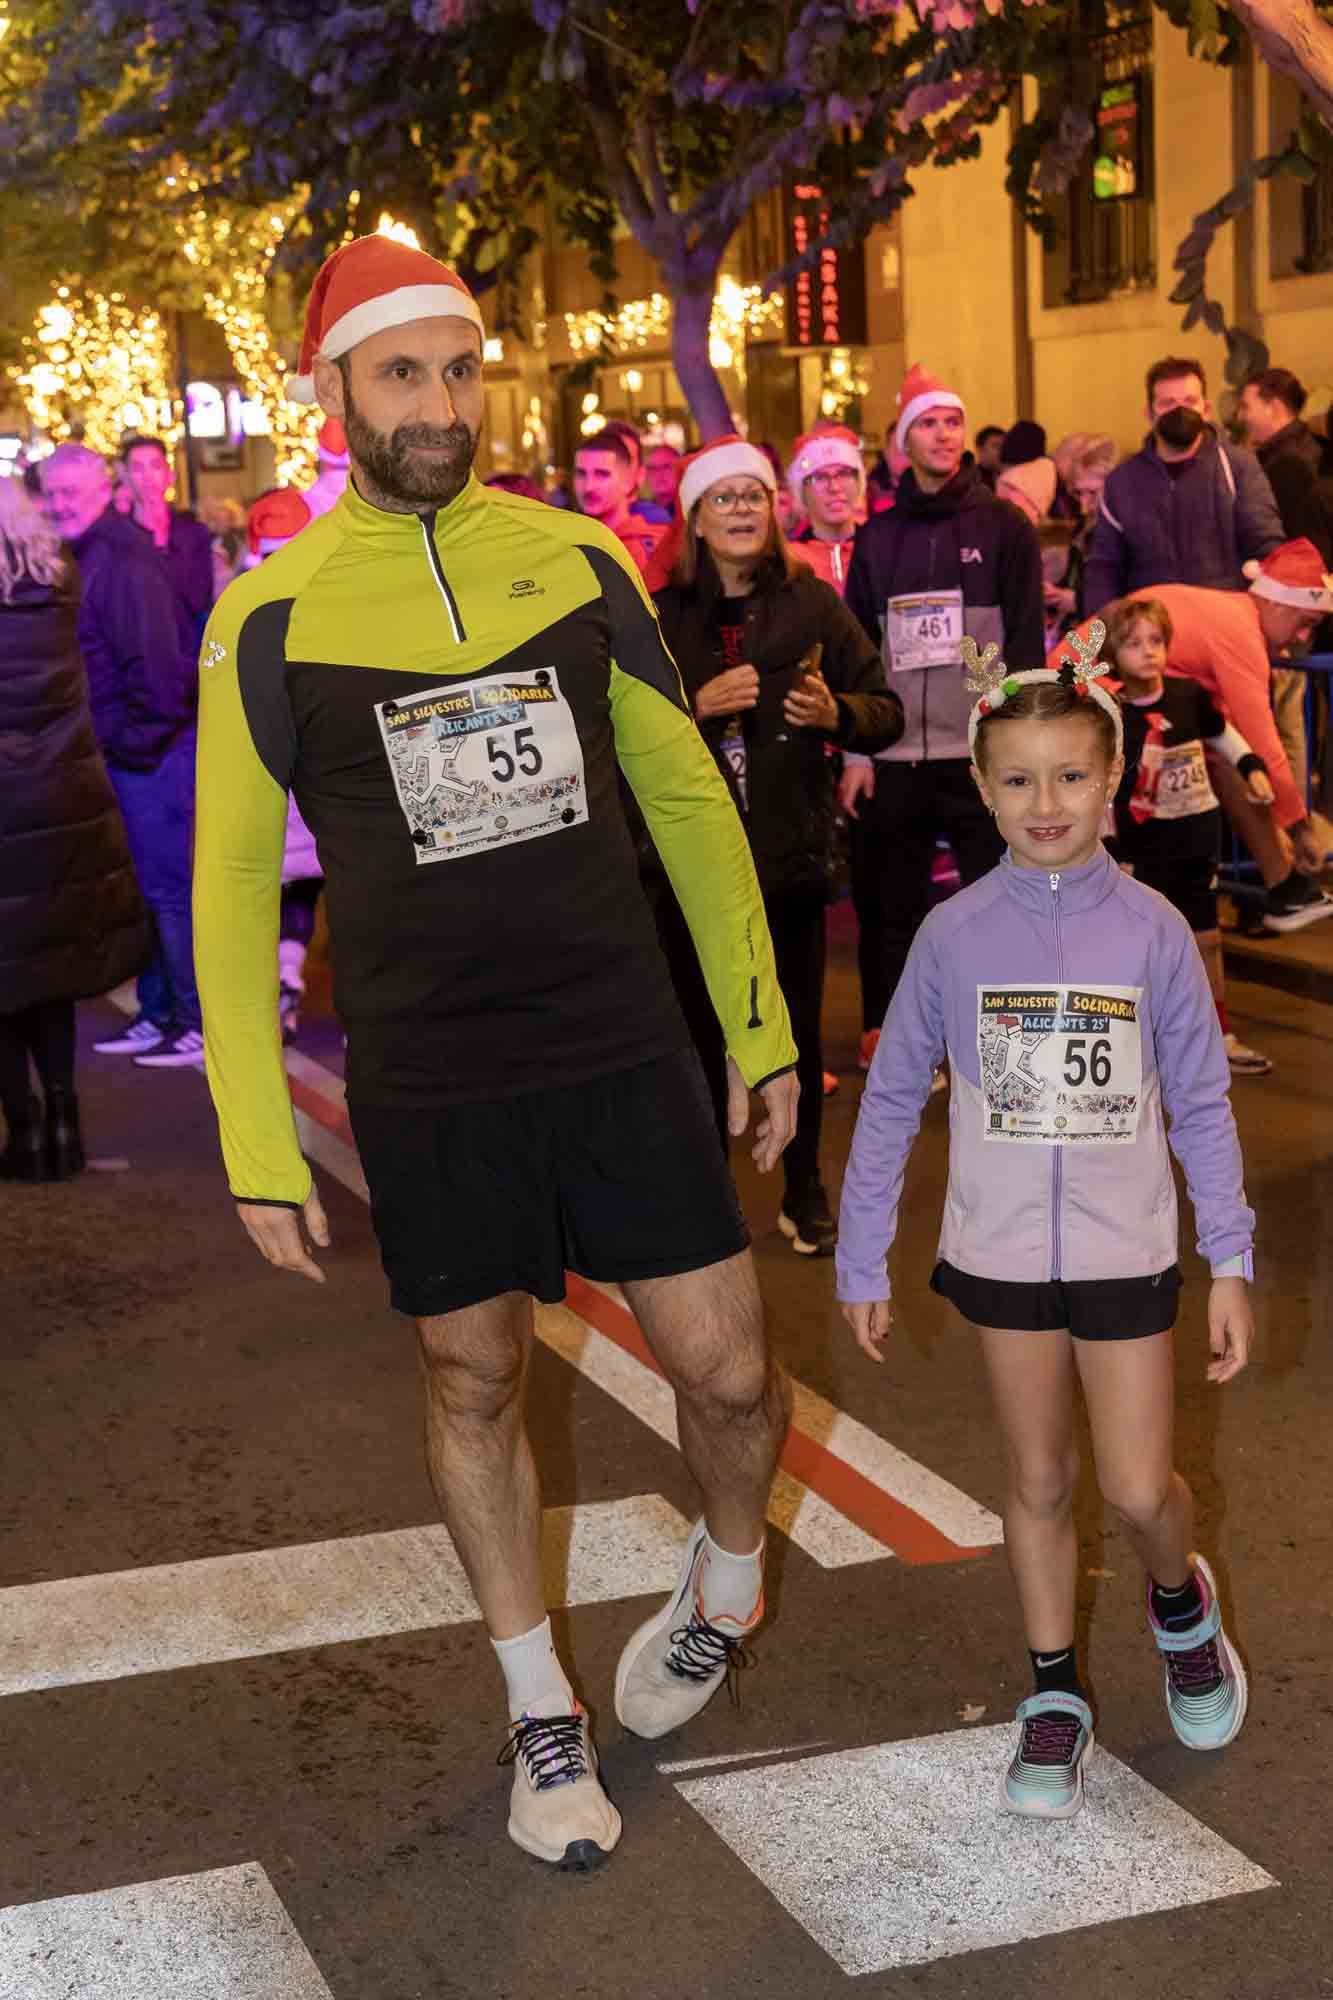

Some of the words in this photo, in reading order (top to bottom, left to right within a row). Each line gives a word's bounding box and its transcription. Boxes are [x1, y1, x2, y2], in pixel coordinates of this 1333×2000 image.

[918, 617, 951, 638] 461
[384, 710, 411, 727] SAN
[414, 696, 472, 721] SILVESTRE
[486, 726, 543, 783] 55
[984, 996, 1005, 1009] SAN
[1023, 1017, 1087, 1031] ALICANTE
[1063, 1039, 1112, 1087] 56
